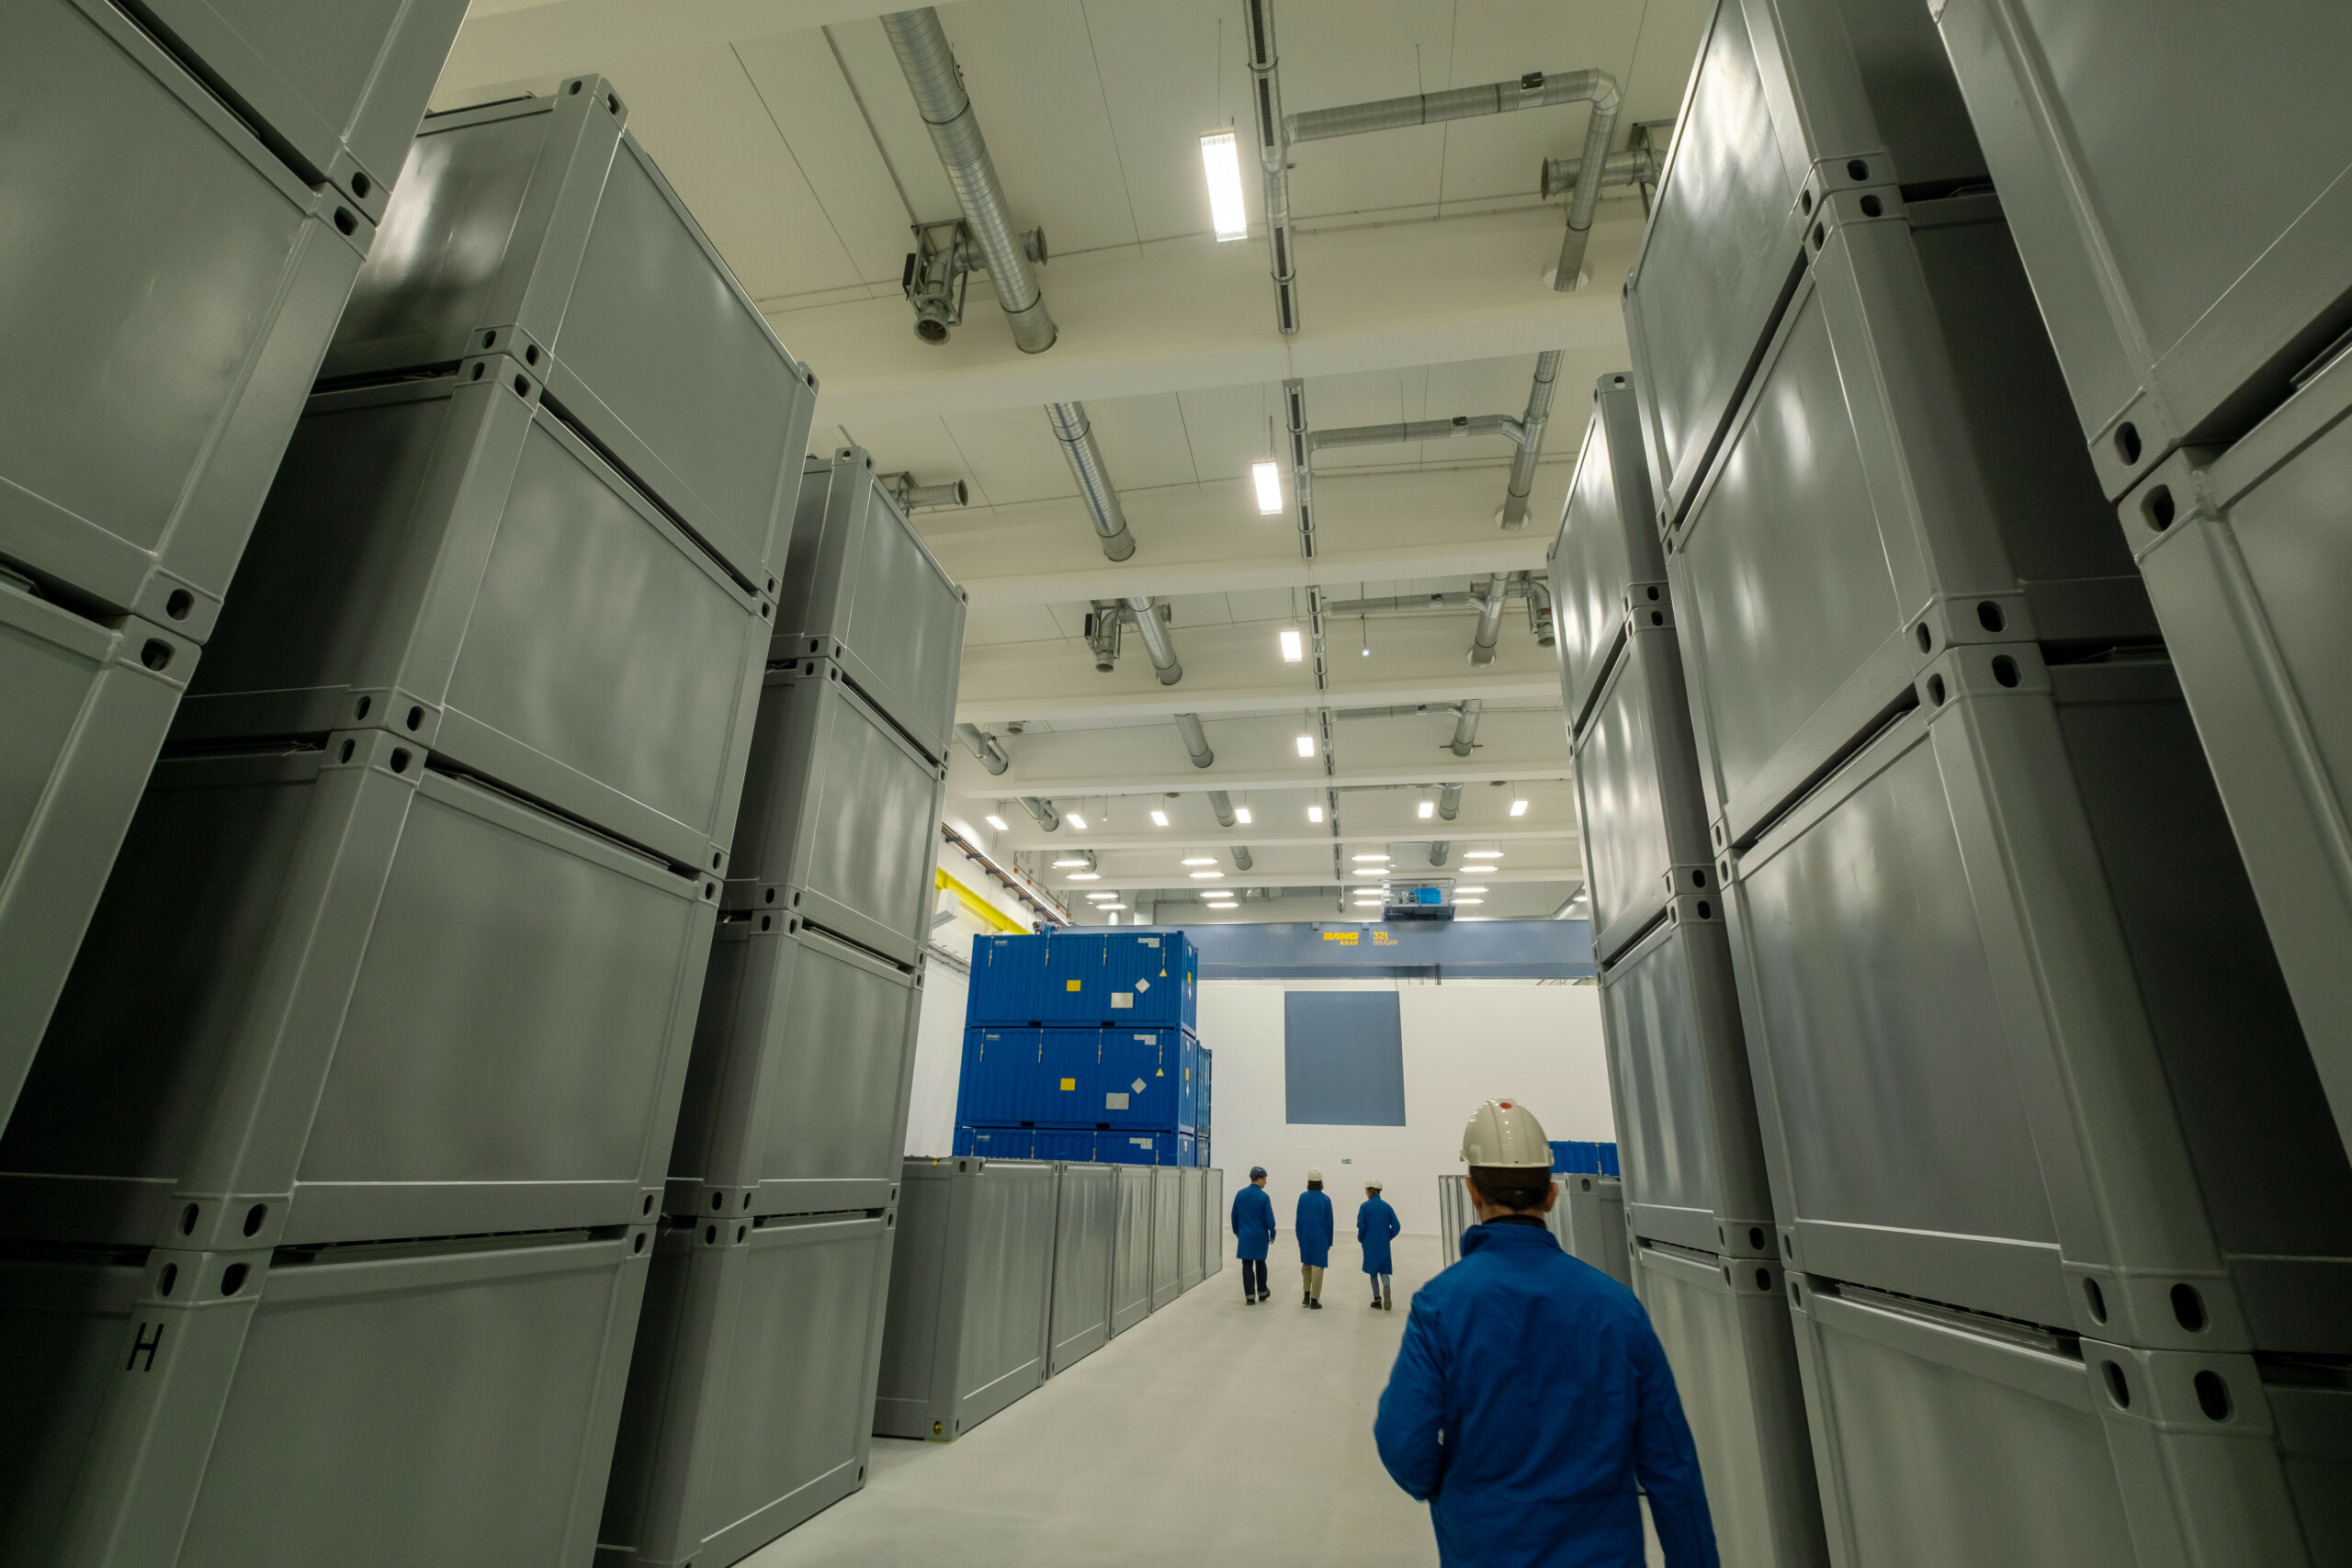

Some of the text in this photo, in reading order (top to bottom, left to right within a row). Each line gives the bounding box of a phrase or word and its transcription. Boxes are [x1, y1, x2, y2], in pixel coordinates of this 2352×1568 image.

[1323, 932, 1359, 941] BANG
[1373, 931, 1388, 940] 32t
[126, 1322, 164, 1371] H
